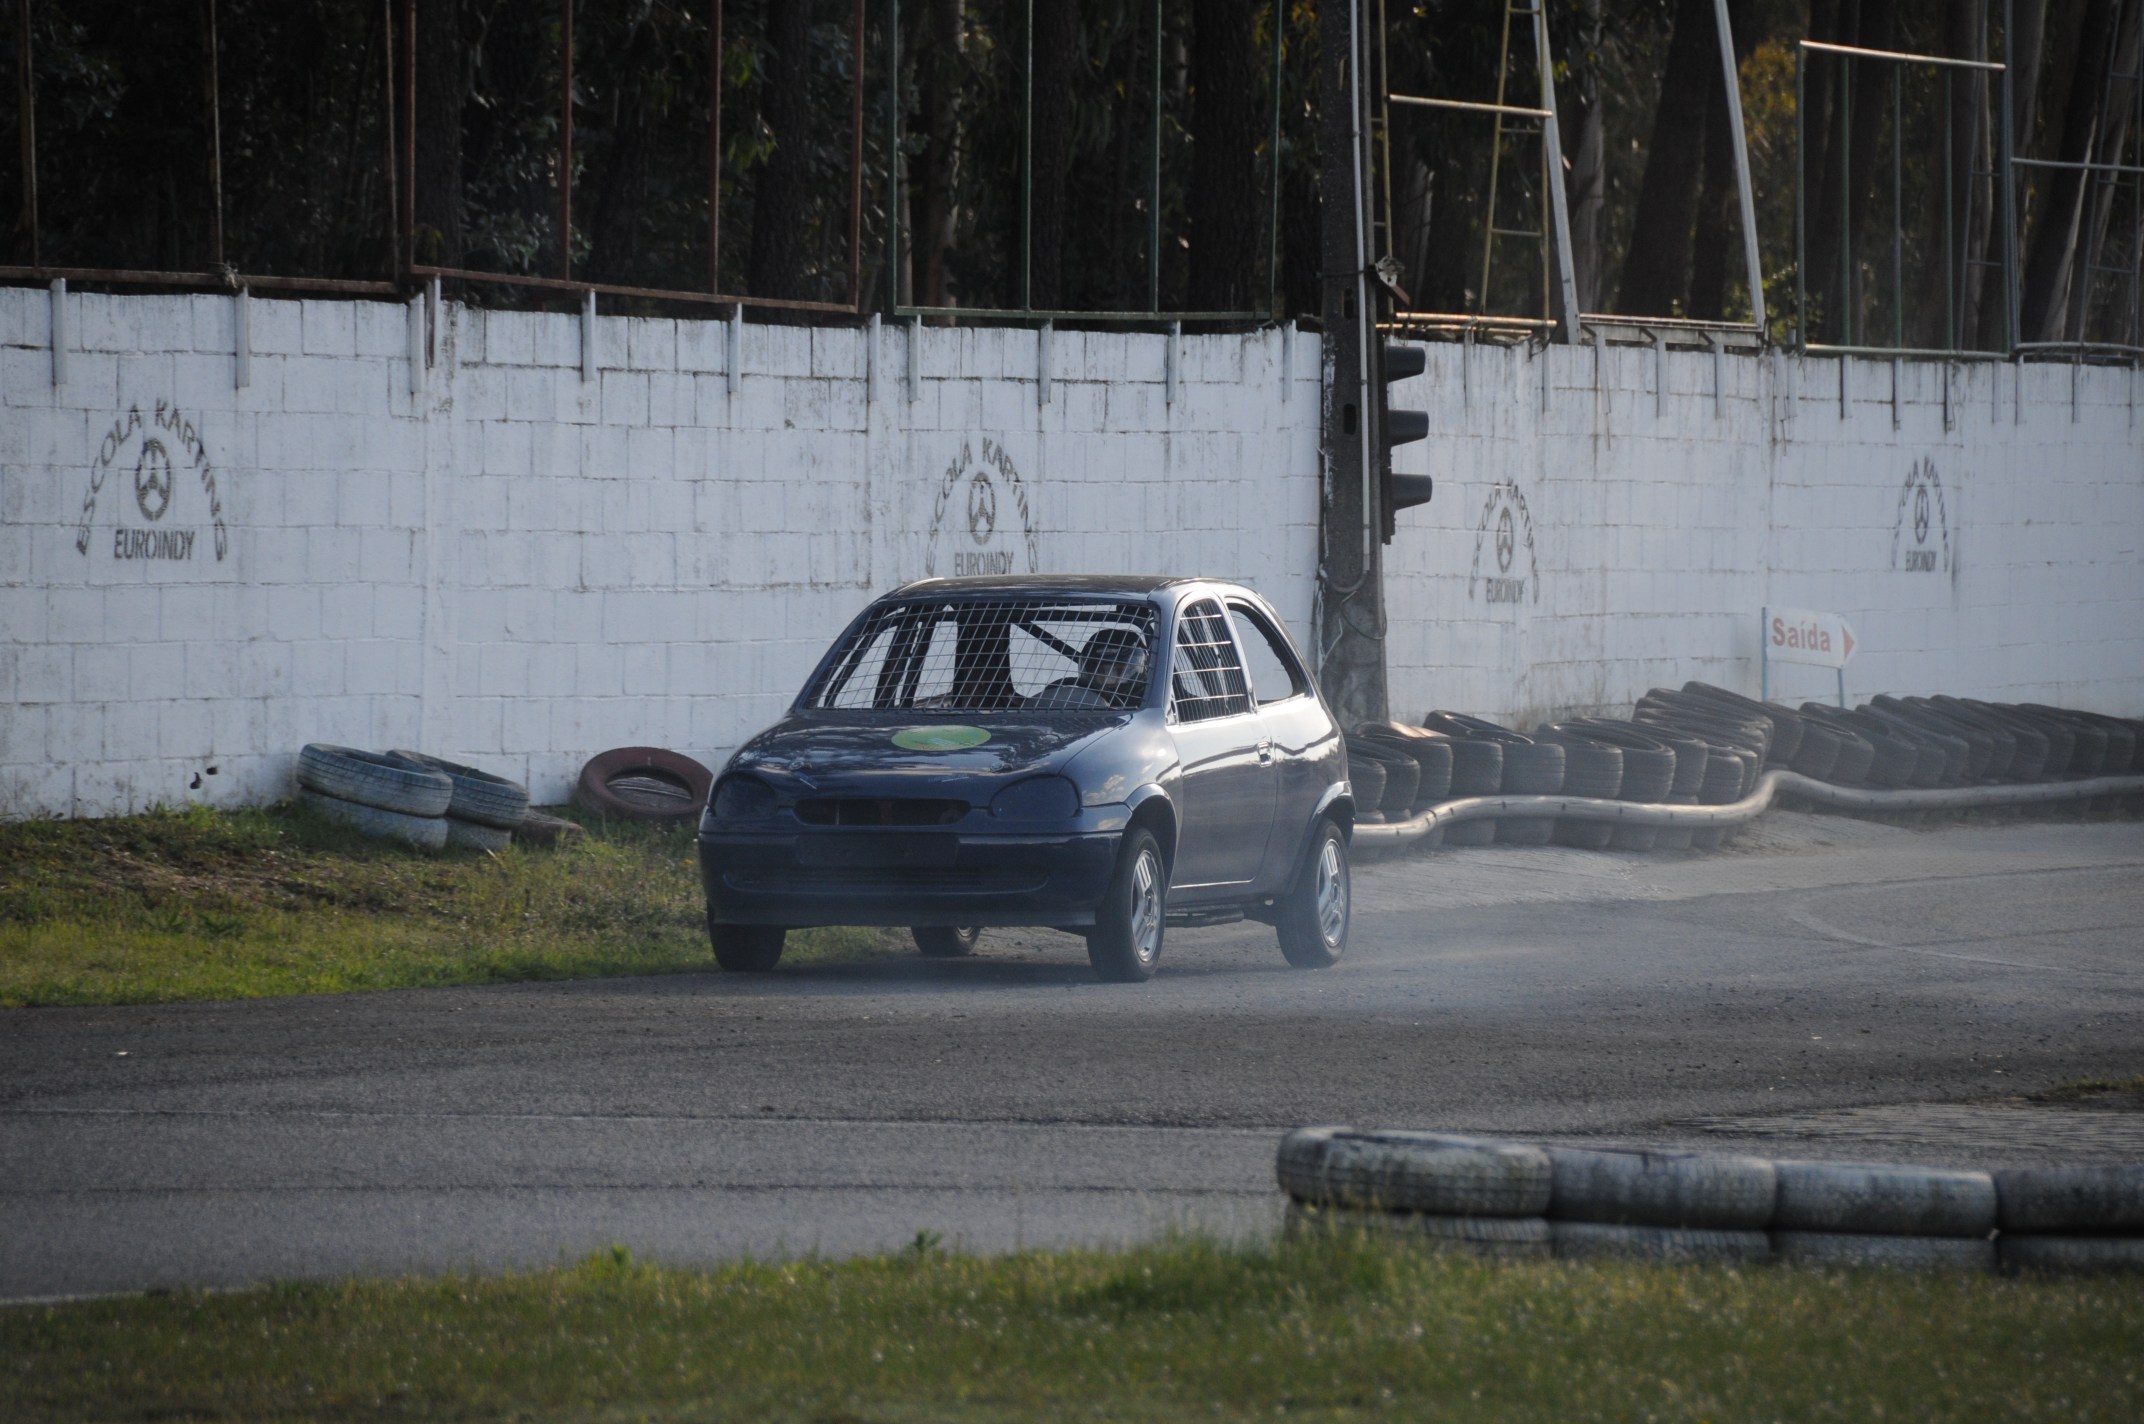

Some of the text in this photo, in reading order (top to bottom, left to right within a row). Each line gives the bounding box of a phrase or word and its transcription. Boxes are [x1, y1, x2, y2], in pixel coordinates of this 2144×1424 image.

[76, 398, 228, 562] ESCOLA KARTING
[113, 528, 196, 561] EUROINDY
[954, 551, 1014, 577] EUROINDY
[1772, 617, 1832, 653] Saída
